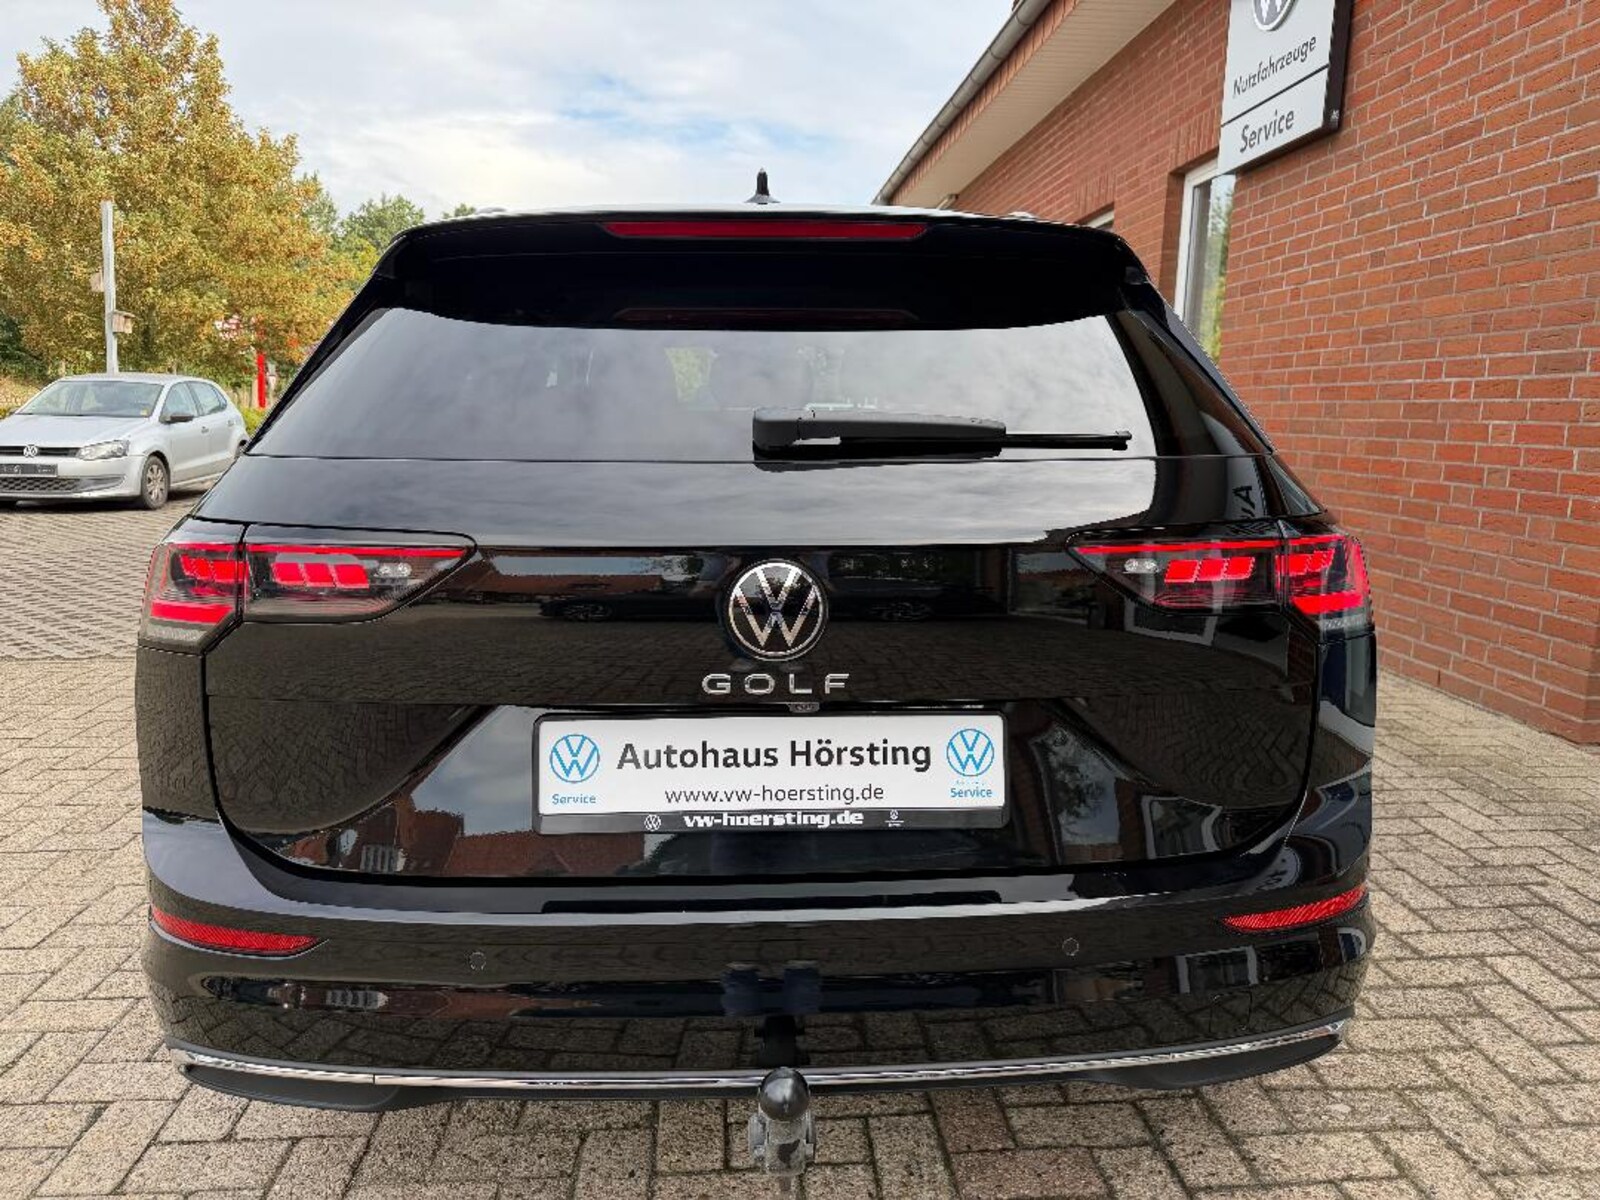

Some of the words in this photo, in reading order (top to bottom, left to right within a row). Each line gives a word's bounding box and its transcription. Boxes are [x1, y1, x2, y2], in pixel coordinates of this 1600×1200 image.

[1232, 36, 1317, 97] Nutzfahrzeuge
[1239, 109, 1295, 153] Service
[701, 673, 850, 695] GOLF
[616, 741, 779, 770] Autohaus
[790, 739, 932, 772] Hörsting
[551, 793, 597, 806] Service
[665, 784, 884, 805] www.vw-hoersting.de
[950, 787, 993, 799] Service
[683, 810, 865, 829] vw-hoersting.de
